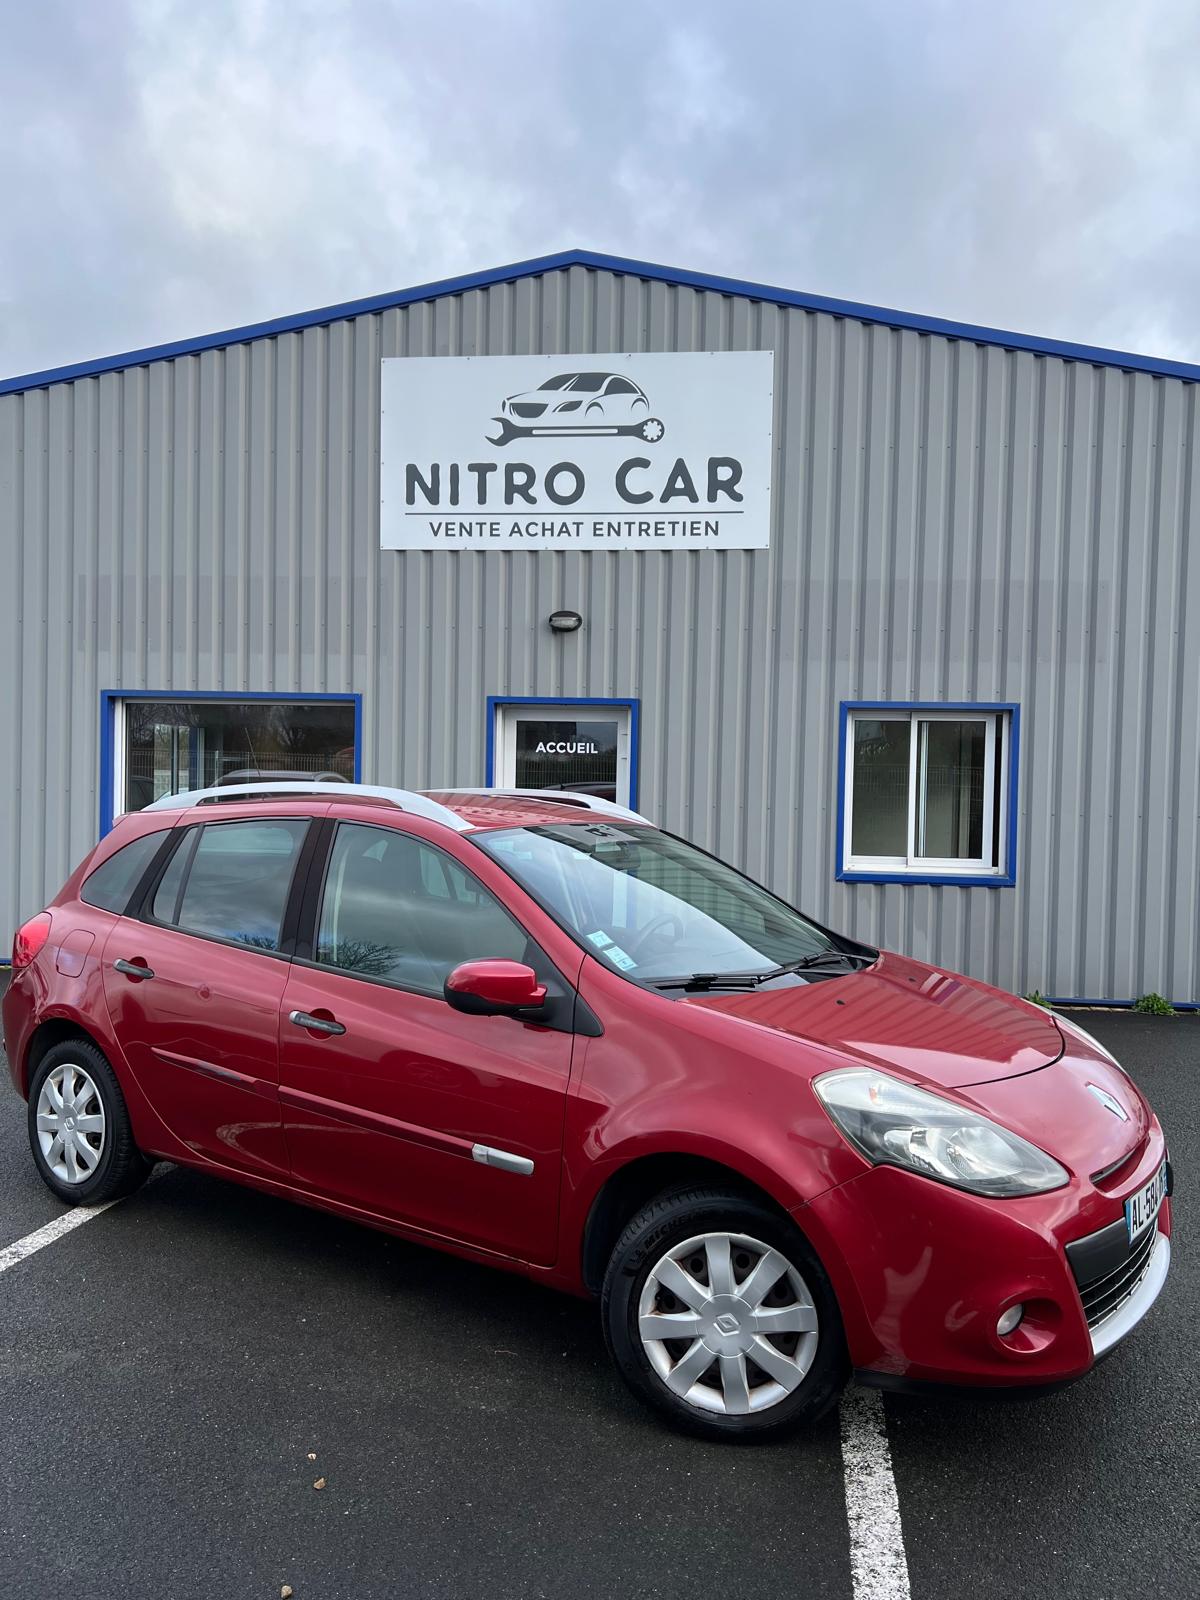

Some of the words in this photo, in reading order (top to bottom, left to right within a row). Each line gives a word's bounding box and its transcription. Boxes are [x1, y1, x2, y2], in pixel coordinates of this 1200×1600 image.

[405, 461, 586, 506] NITRO
[615, 456, 744, 505] CAR
[428, 521, 501, 538] VENTE
[508, 521, 584, 538] ACHAT
[592, 520, 719, 537] ENTRETIEN
[535, 741, 599, 754] ACCUEIL
